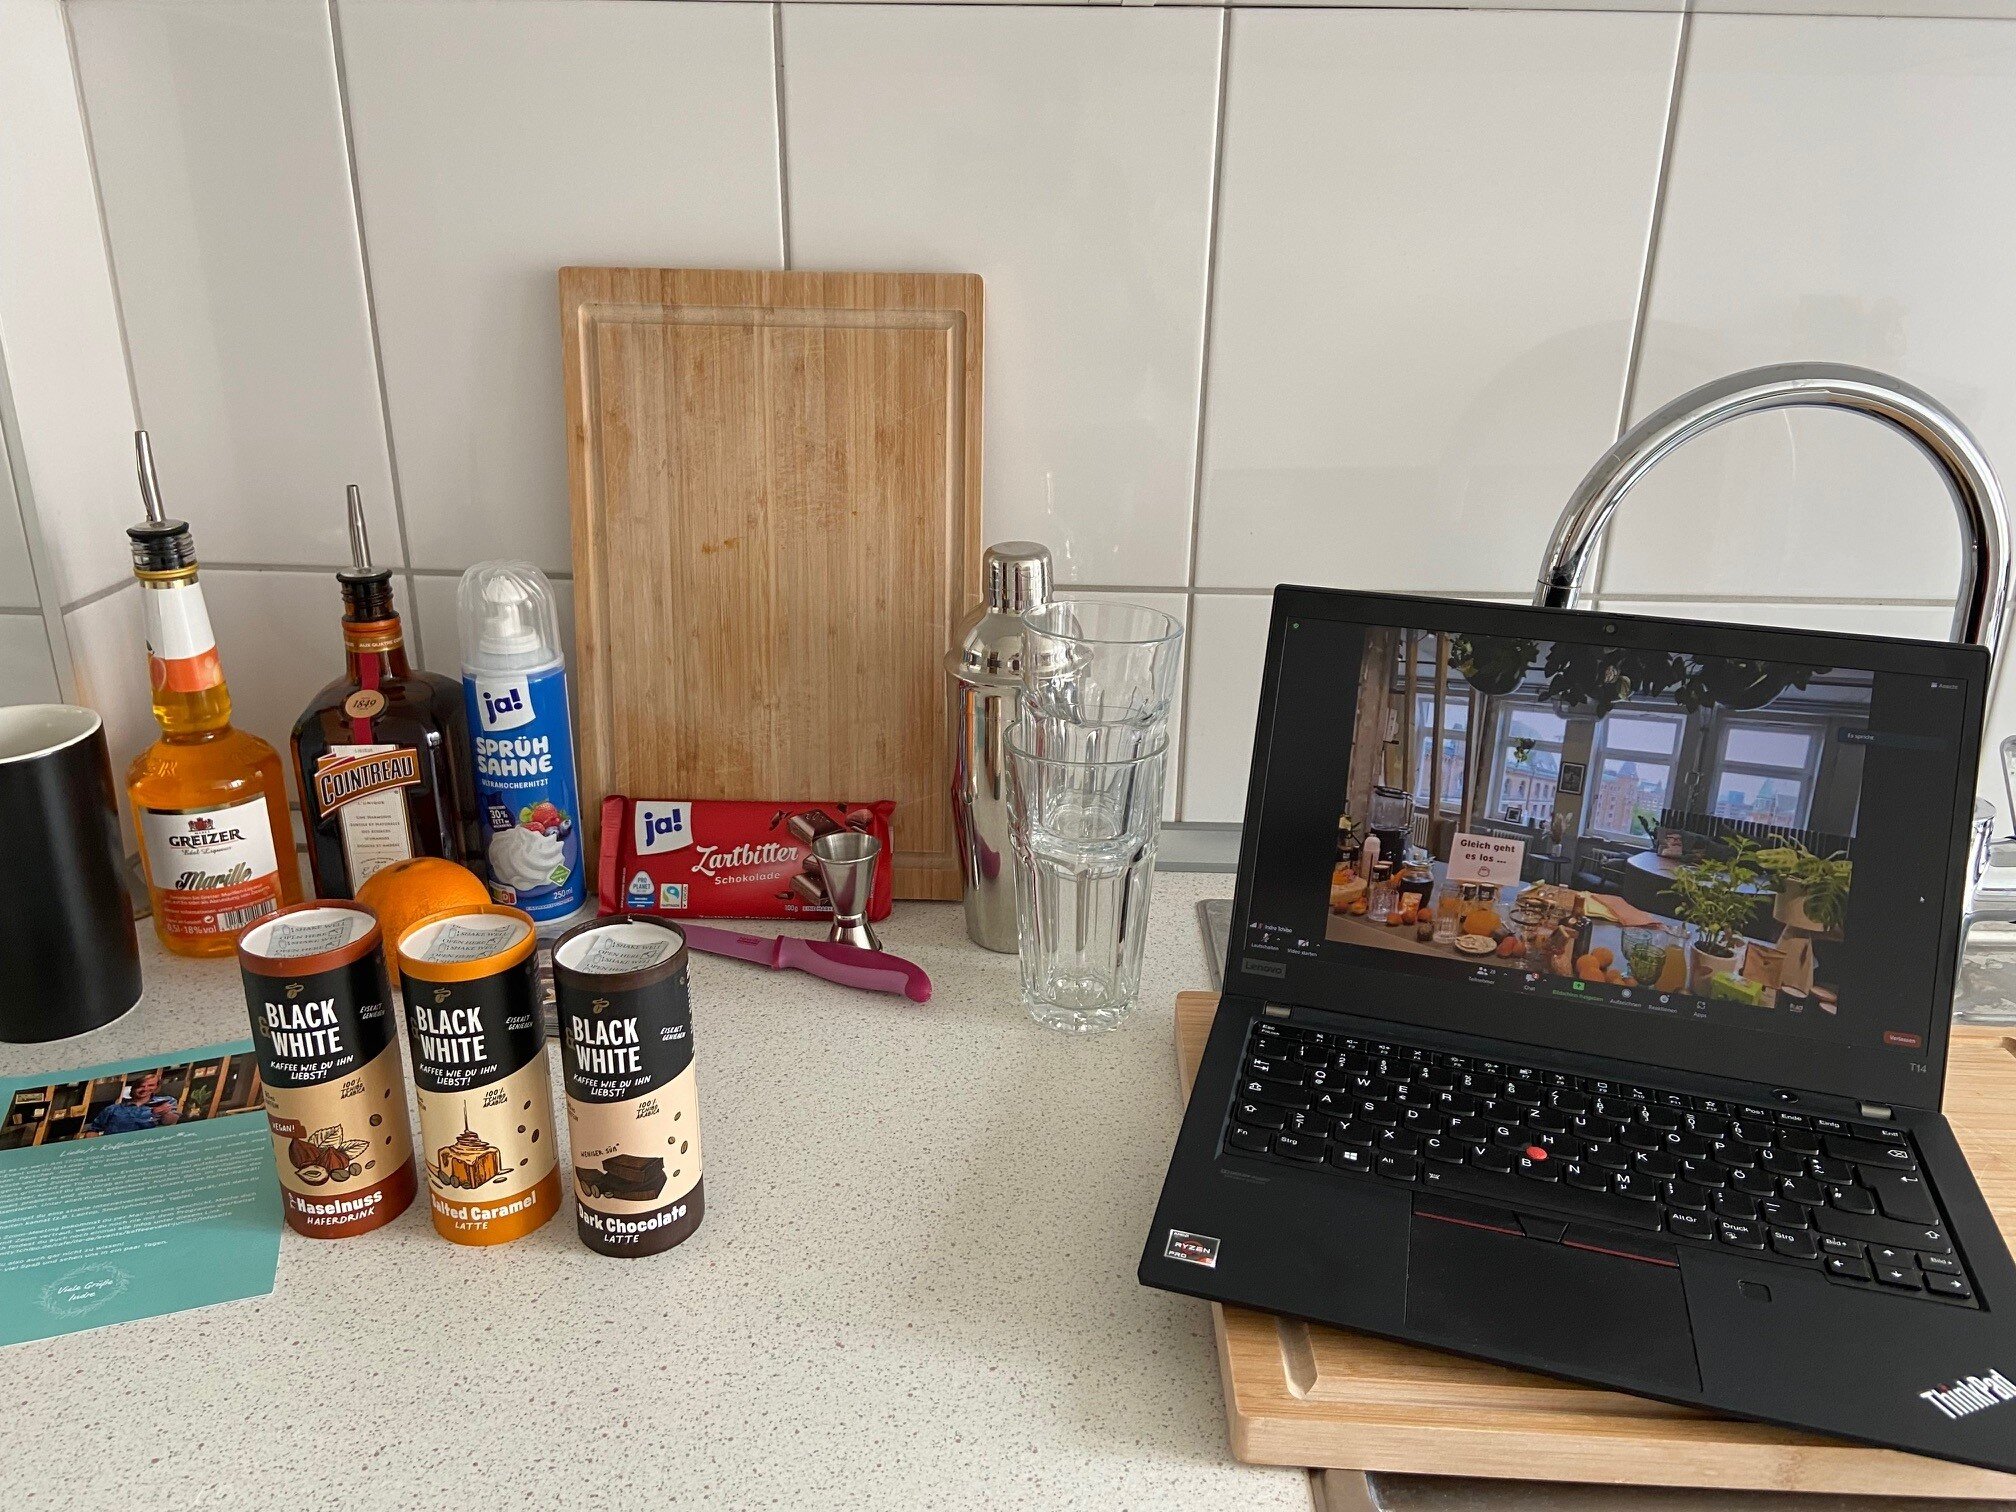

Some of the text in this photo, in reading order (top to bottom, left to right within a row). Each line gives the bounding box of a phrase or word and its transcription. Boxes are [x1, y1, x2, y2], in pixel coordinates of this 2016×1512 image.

[353, 699, 377, 709] 1849
[483, 688, 523, 724] ja!
[476, 735, 549, 758] SPRÜH
[477, 754, 553, 777] SAHNE
[321, 756, 413, 806] COINTREAU
[489, 810, 508, 818] 30%
[644, 809, 683, 846] ja!
[169, 828, 246, 849] GREIZER
[1460, 839, 1515, 853] Gleich geht
[691, 842, 799, 877] Zartbitter
[1479, 853, 1494, 862] los
[175, 862, 252, 890] Marille
[714, 871, 781, 885] Schokolade
[1245, 963, 1282, 975] Lenovo
[1524, 984, 1536, 992] Chat
[265, 998, 338, 1029] BLACK
[415, 1005, 483, 1035] BLACK
[572, 1015, 639, 1046] BLACK
[271, 1027, 343, 1058] WHITE
[420, 1034, 488, 1063] WHITE
[270, 1055, 354, 1071] KAFFEE WIE DU IHN
[575, 1044, 643, 1074] WHITE
[420, 1064, 443, 1076] KAFFEE
[465, 1068, 477, 1076] DU
[480, 1064, 498, 1075] IHN
[1910, 1062, 1927, 1073] T14
[291, 1070, 327, 1080] LIEBST!
[1315, 1070, 1327, 1079] Q
[437, 1077, 471, 1086] LIEBST!
[573, 1074, 652, 1088] KAFFEE WIE DU IHN
[1357, 1078, 1371, 1086] W
[340, 1088, 365, 1099] ARABICA
[591, 1087, 625, 1097] LIEBST!
[1442, 1093, 1452, 1101] R
[483, 1097, 508, 1108] ARABICA
[1364, 1102, 1375, 1110] S
[1485, 1100, 1496, 1108] T
[636, 1108, 660, 1120] ARABICA
[1407, 1110, 1419, 1118] D
[1530, 1109, 1540, 1118] Z
[1340, 1121, 1350, 1130] Y
[1452, 1118, 1462, 1126] F
[1575, 1116, 1586, 1125] U
[272, 1122, 295, 1133] VEGAN!
[1497, 1127, 1510, 1136] G
[1384, 1129, 1395, 1139] X
[1543, 1134, 1554, 1144] H
[1668, 1133, 1681, 1142] O
[1281, 1136, 1298, 1145] Strg
[1429, 1139, 1440, 1147] C
[1475, 1146, 1486, 1155] V
[1590, 1144, 1598, 1152] J
[1715, 1142, 1725, 1150] P
[1637, 1151, 1648, 1162] K
[1521, 1158, 1532, 1167] B
[1685, 1160, 1695, 1170] L
[1569, 1164, 1580, 1174] N
[1734, 1169, 1746, 1179] Ö
[1617, 1173, 1630, 1183] M
[1784, 1178, 1795, 1188] Ä
[296, 1190, 383, 1215] Haselnuss
[431, 1190, 537, 1221] Salted Caramel
[307, 1207, 375, 1226] HAFERDRINK
[578, 1203, 687, 1234] Dark Chocolate
[455, 1221, 489, 1230] LATTE
[1723, 1222, 1749, 1232] Druck
[604, 1234, 639, 1243] LATTE
[1775, 1232, 1795, 1242] Strg
[1175, 1241, 1211, 1254] RYZEN
[1168, 1250, 1187, 1259] PRO
[57, 1285, 81, 1294] Viele
[1919, 1368, 2016, 1419] ThinkPad
